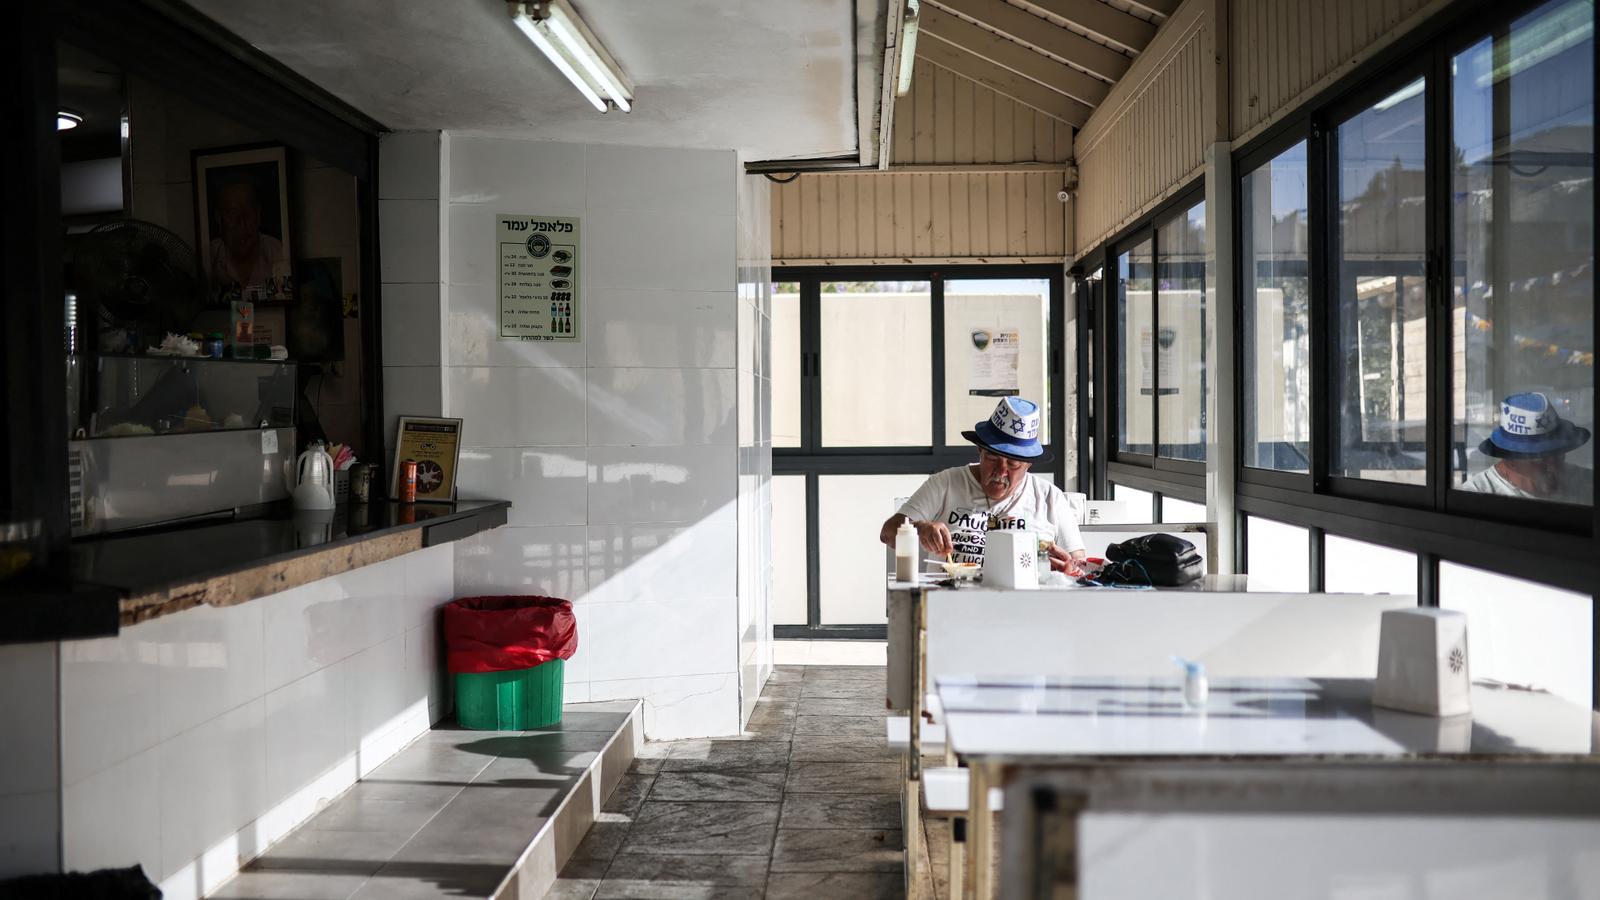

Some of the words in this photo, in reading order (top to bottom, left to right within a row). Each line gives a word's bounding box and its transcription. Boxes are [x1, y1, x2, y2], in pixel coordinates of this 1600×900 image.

[502, 220, 528, 231] עמר
[531, 219, 573, 232] פלאפל
[961, 545, 979, 553] AND
